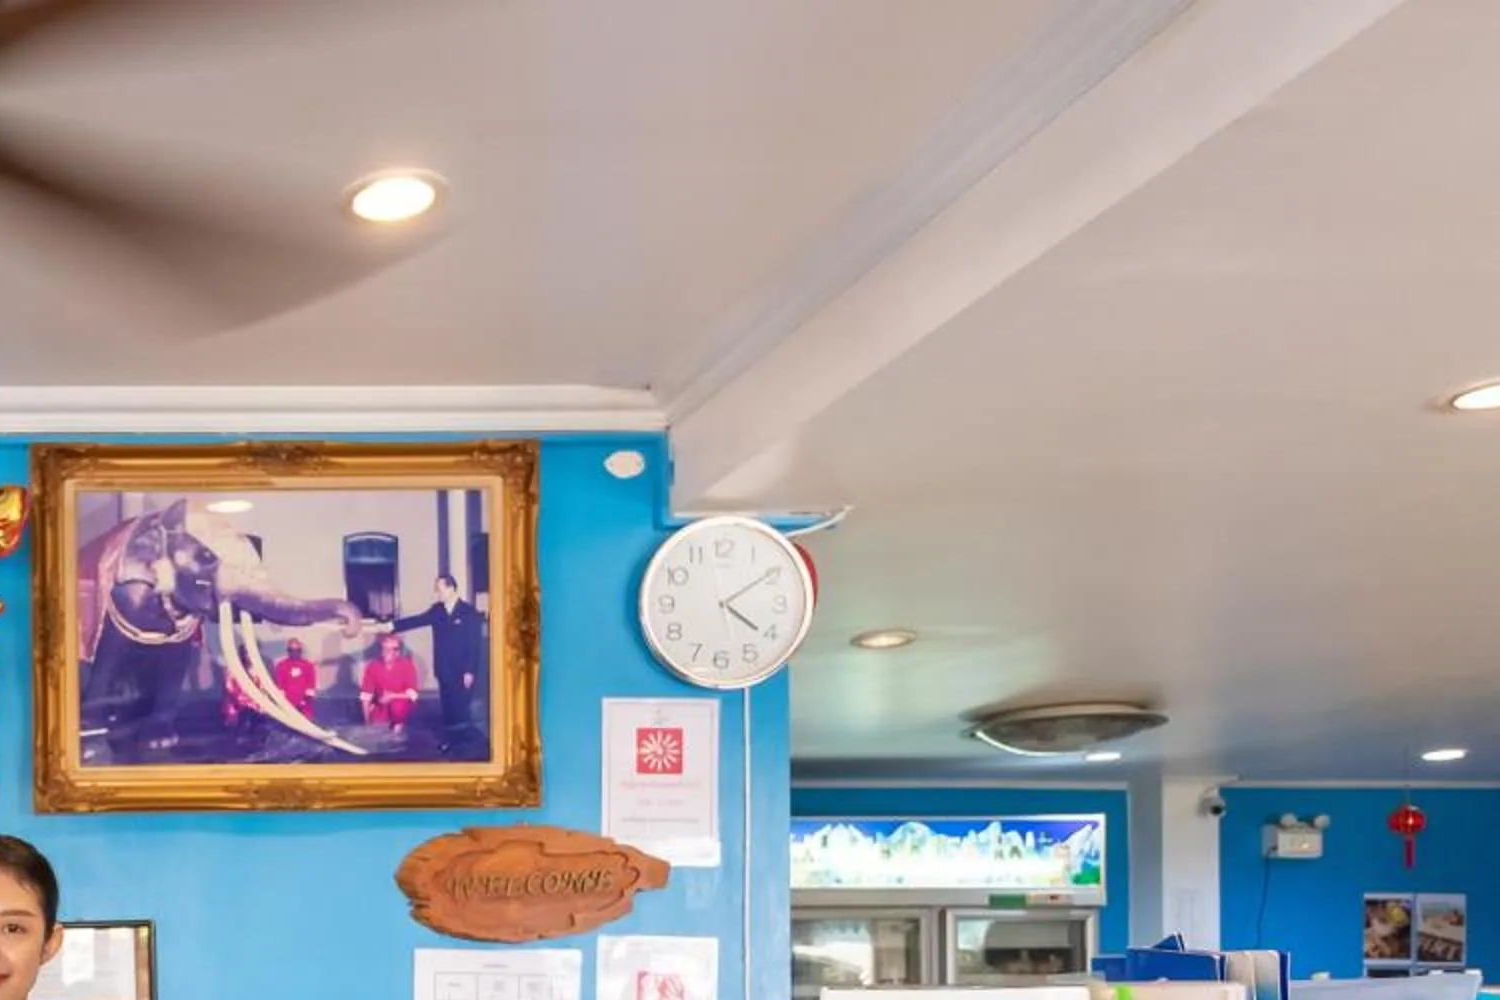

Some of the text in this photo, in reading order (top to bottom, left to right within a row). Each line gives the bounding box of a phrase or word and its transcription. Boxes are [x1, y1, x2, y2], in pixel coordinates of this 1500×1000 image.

[714, 539, 734, 558] 12
[667, 567, 689, 586] 10
[658, 595, 675, 614] 9
[772, 596, 787, 613] 3
[666, 623, 682, 641] 8
[763, 624, 778, 641] 4
[690, 643, 704, 662] 7
[713, 651, 730, 669] 6
[742, 644, 759, 663] 5
[450, 868, 616, 900] WELCOME
